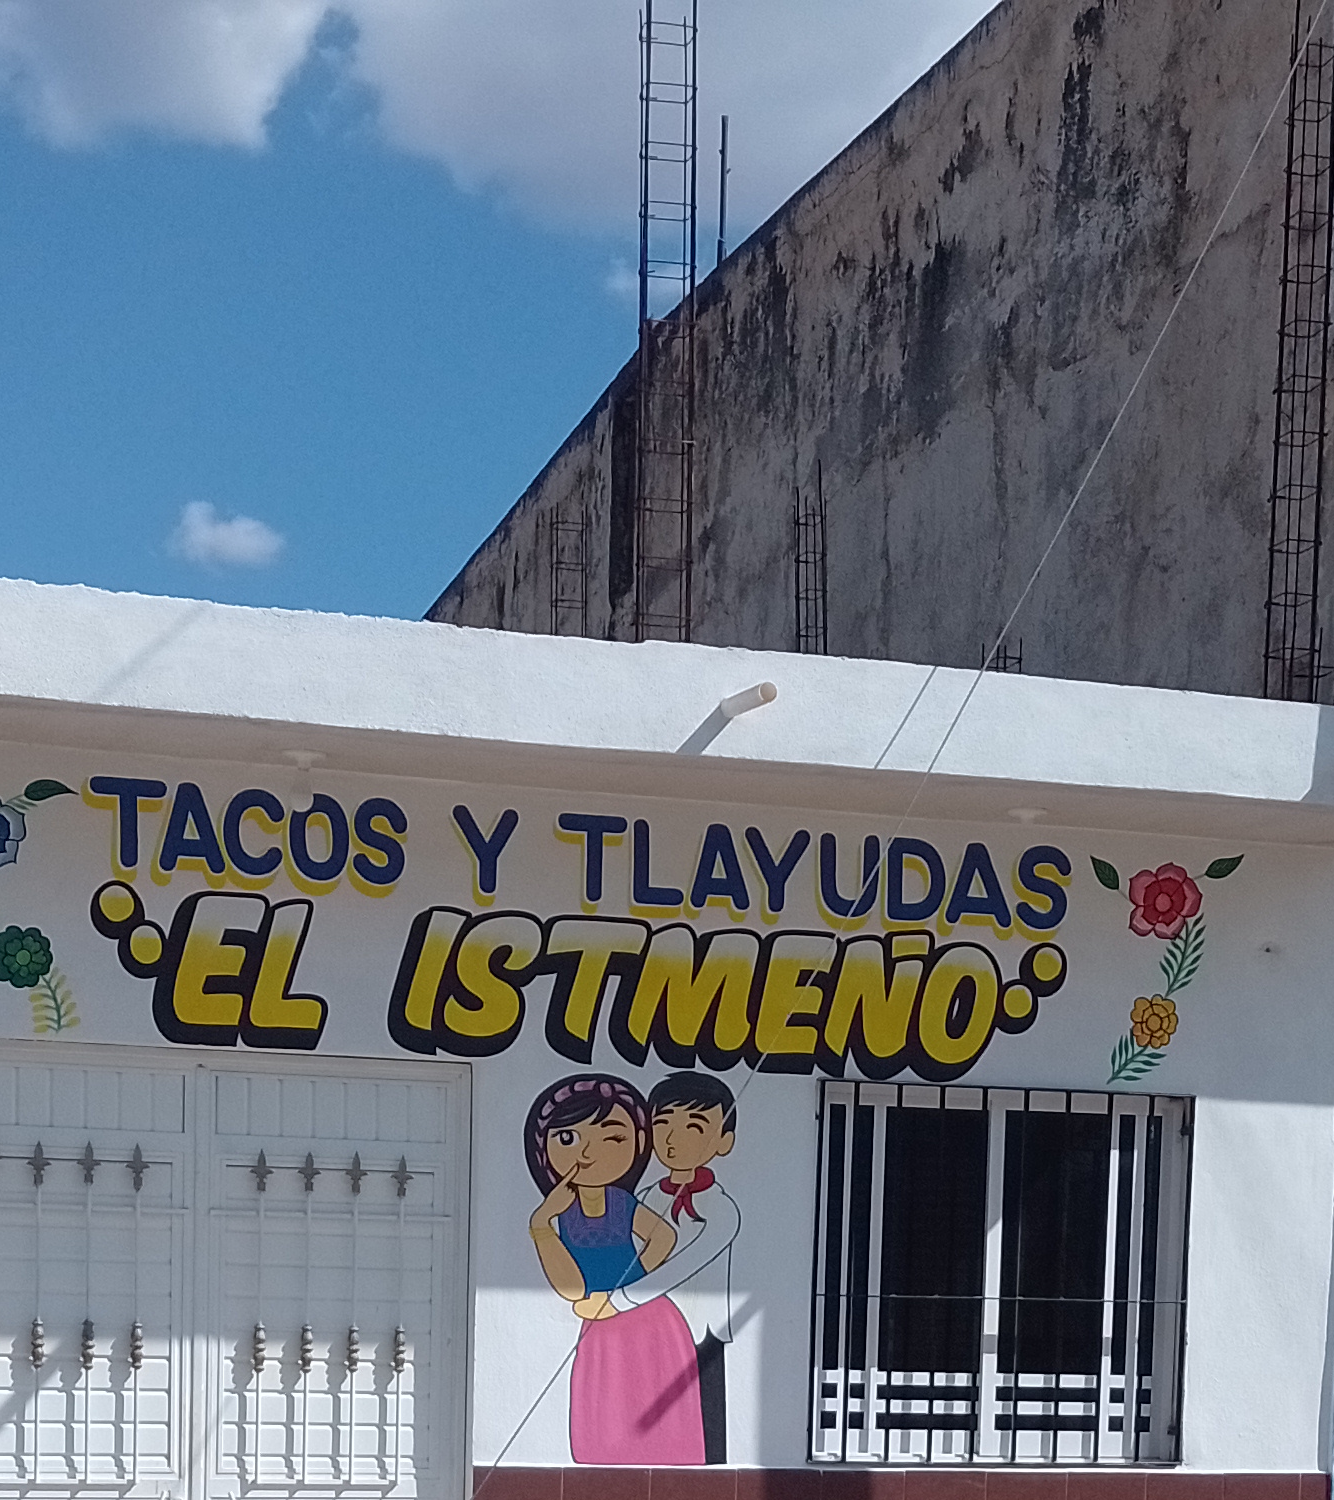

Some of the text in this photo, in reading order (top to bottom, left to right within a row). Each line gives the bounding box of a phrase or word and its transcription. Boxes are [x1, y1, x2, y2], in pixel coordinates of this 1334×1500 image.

[83, 775, 1072, 941] TACOS Y TLAYUDAS
[153, 890, 1005, 1083] EL ISTMEÑO
